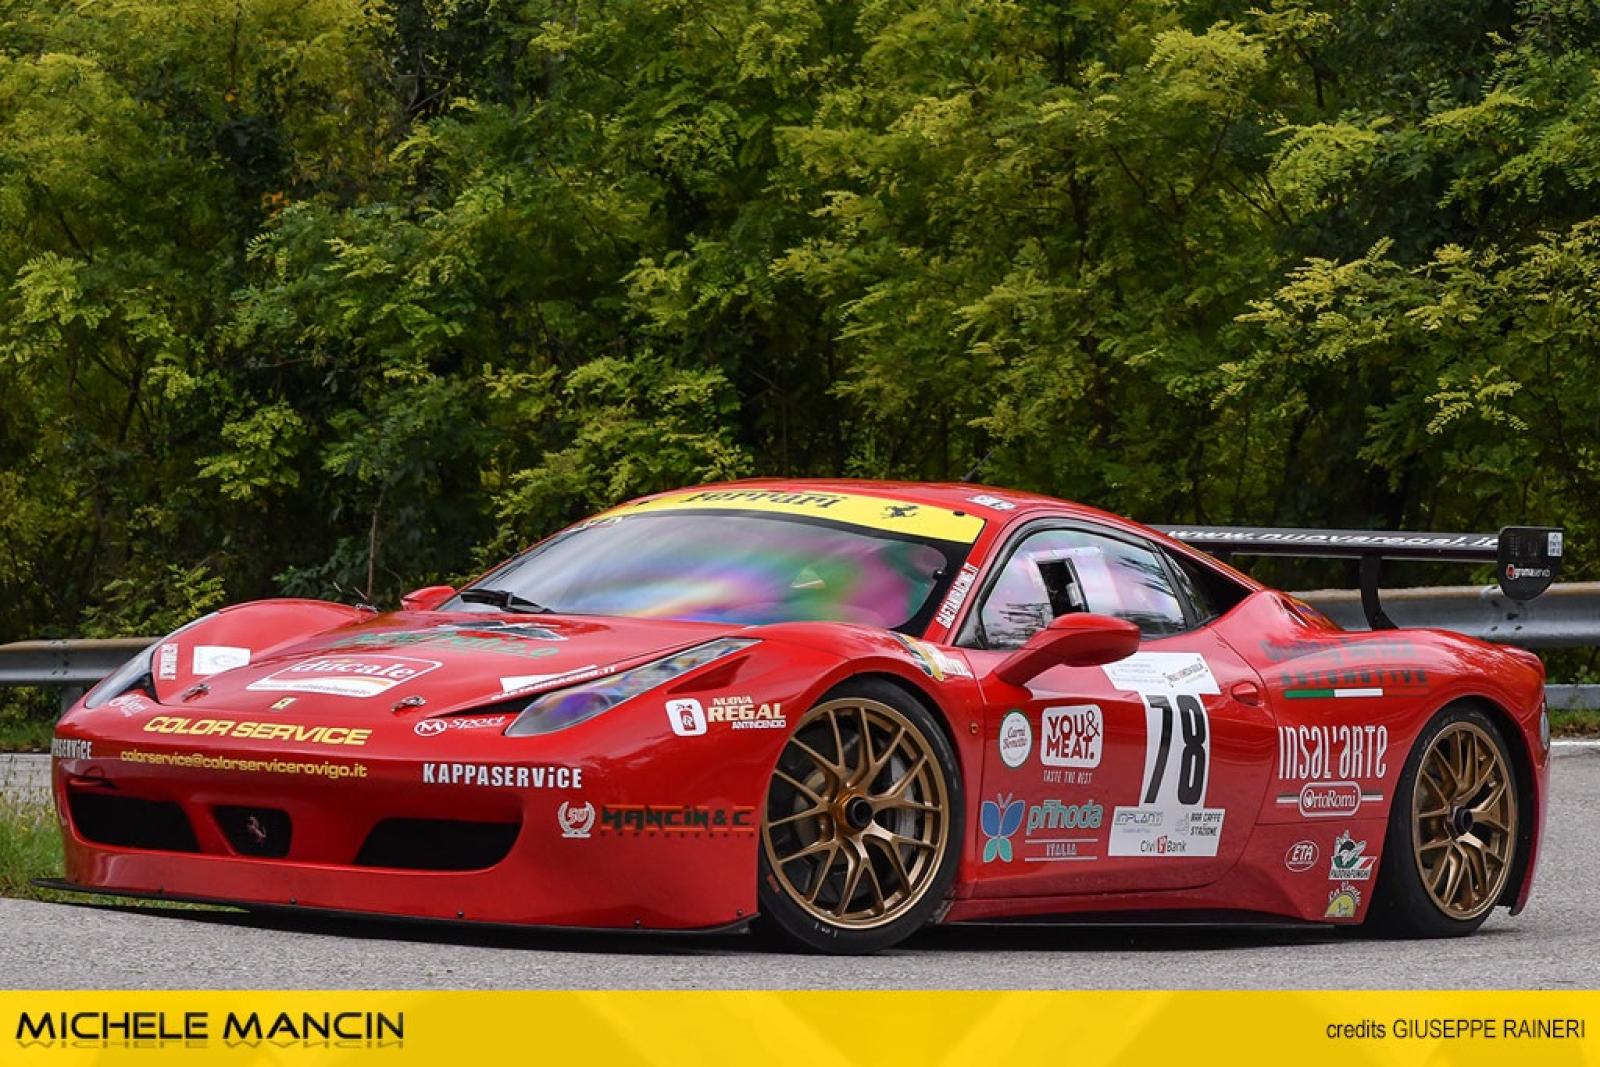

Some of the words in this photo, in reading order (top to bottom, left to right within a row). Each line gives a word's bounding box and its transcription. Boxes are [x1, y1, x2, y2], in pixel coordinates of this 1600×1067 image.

[678, 491, 847, 509] Ferrari
[713, 697, 753, 706] NUOVA
[707, 703, 787, 723] REGAL
[144, 716, 236, 737] COLOR
[231, 722, 373, 745] SERVICE
[1047, 711, 1100, 740] YOU&
[1046, 736, 1095, 760] MEAT.
[1144, 695, 1207, 805] 78
[121, 749, 368, 778] colorservice@colorservicerovigo.it
[1046, 843, 1078, 857] ITALIA
[1291, 844, 1313, 862] ETA
